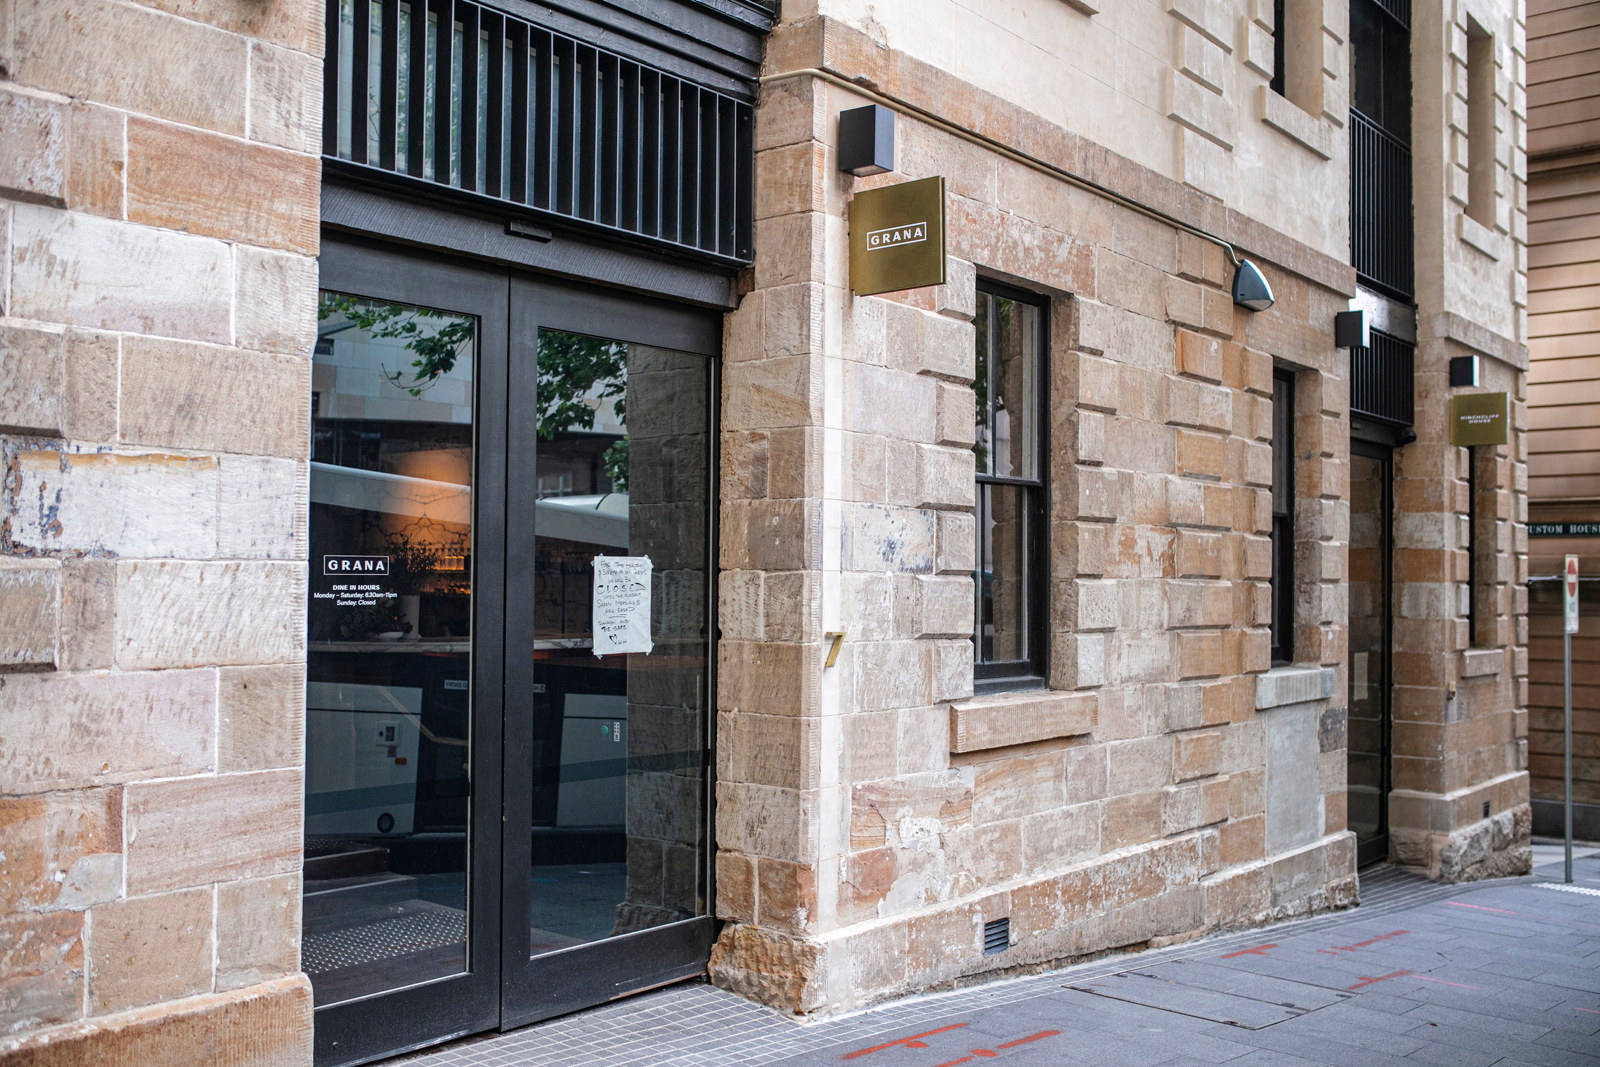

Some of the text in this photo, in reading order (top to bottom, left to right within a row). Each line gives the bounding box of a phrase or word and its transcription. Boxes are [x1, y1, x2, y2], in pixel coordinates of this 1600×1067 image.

[870, 227, 923, 246] GRANA
[1528, 524, 1563, 534] USTOM
[327, 560, 386, 571] GRANA
[596, 582, 646, 594] CLOSED
